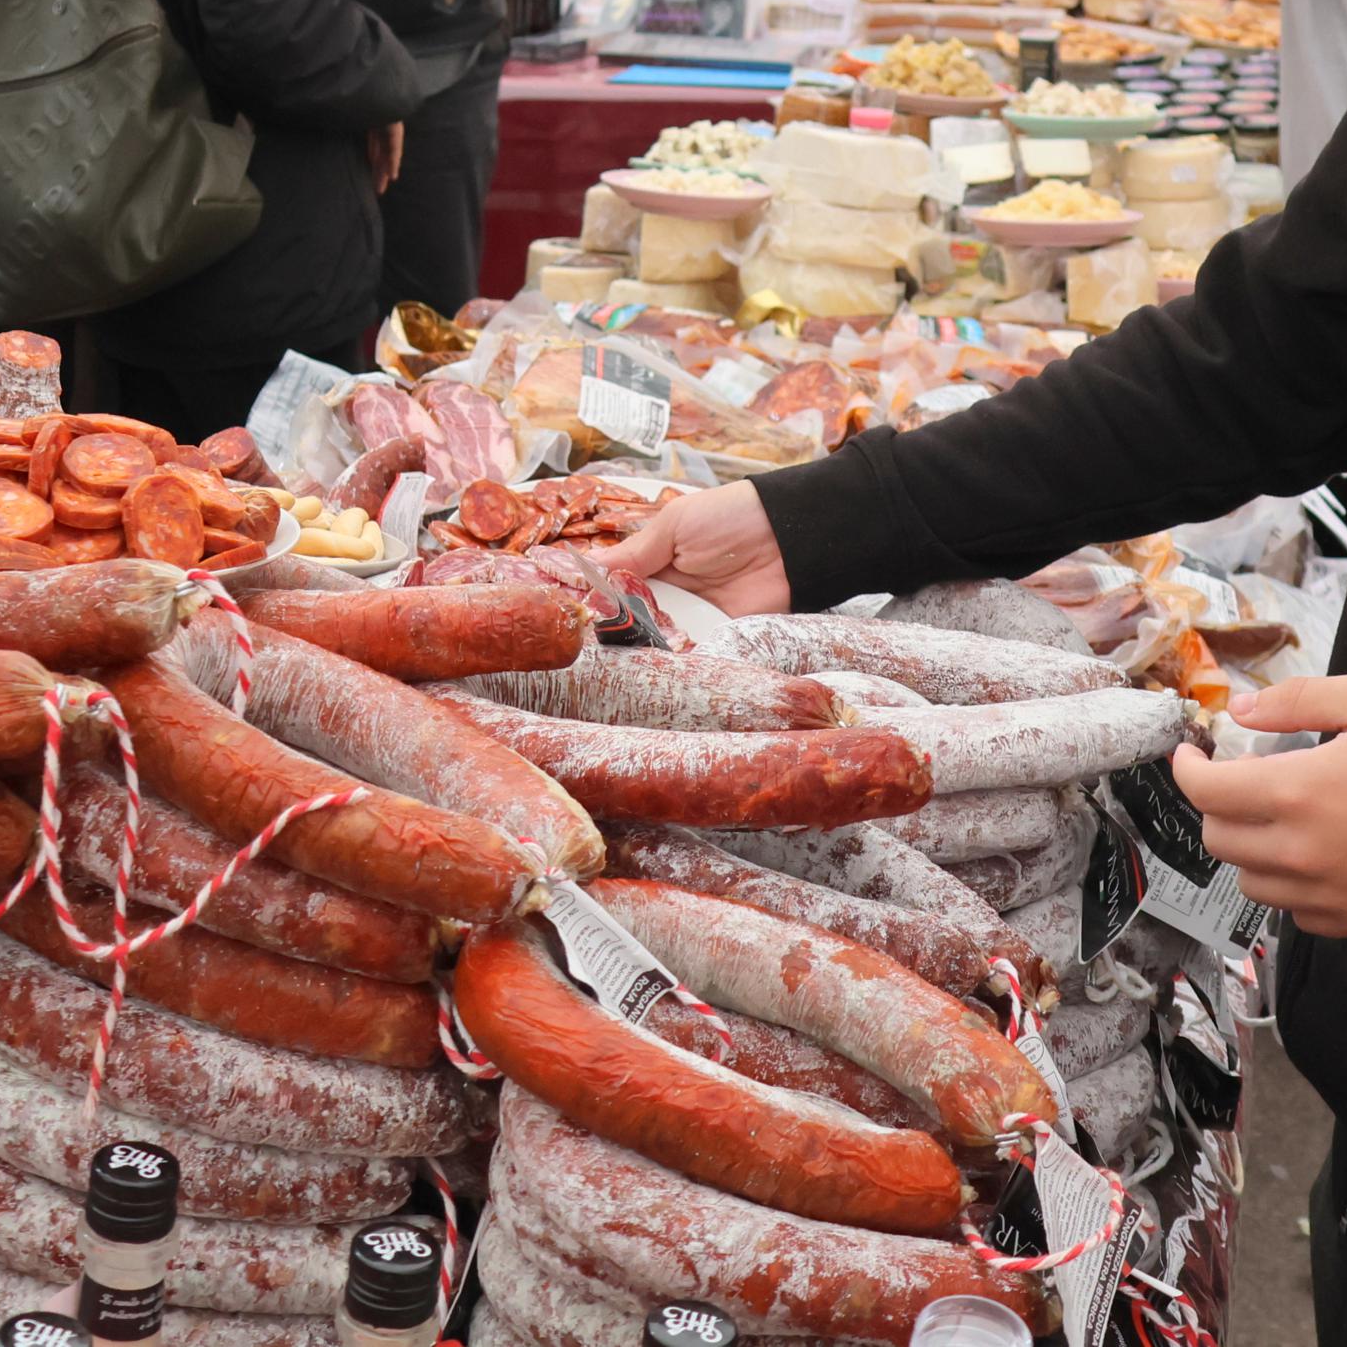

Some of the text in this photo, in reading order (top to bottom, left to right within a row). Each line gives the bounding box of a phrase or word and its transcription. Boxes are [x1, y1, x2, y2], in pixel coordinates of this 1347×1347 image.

[1235, 899, 1258, 934] BERICA
[625, 975, 650, 1002] ROJA
[1086, 1244, 1116, 1331] EXTRA IBERICA
[1091, 1207, 1141, 1347] LONGANIZA HERRADURA
